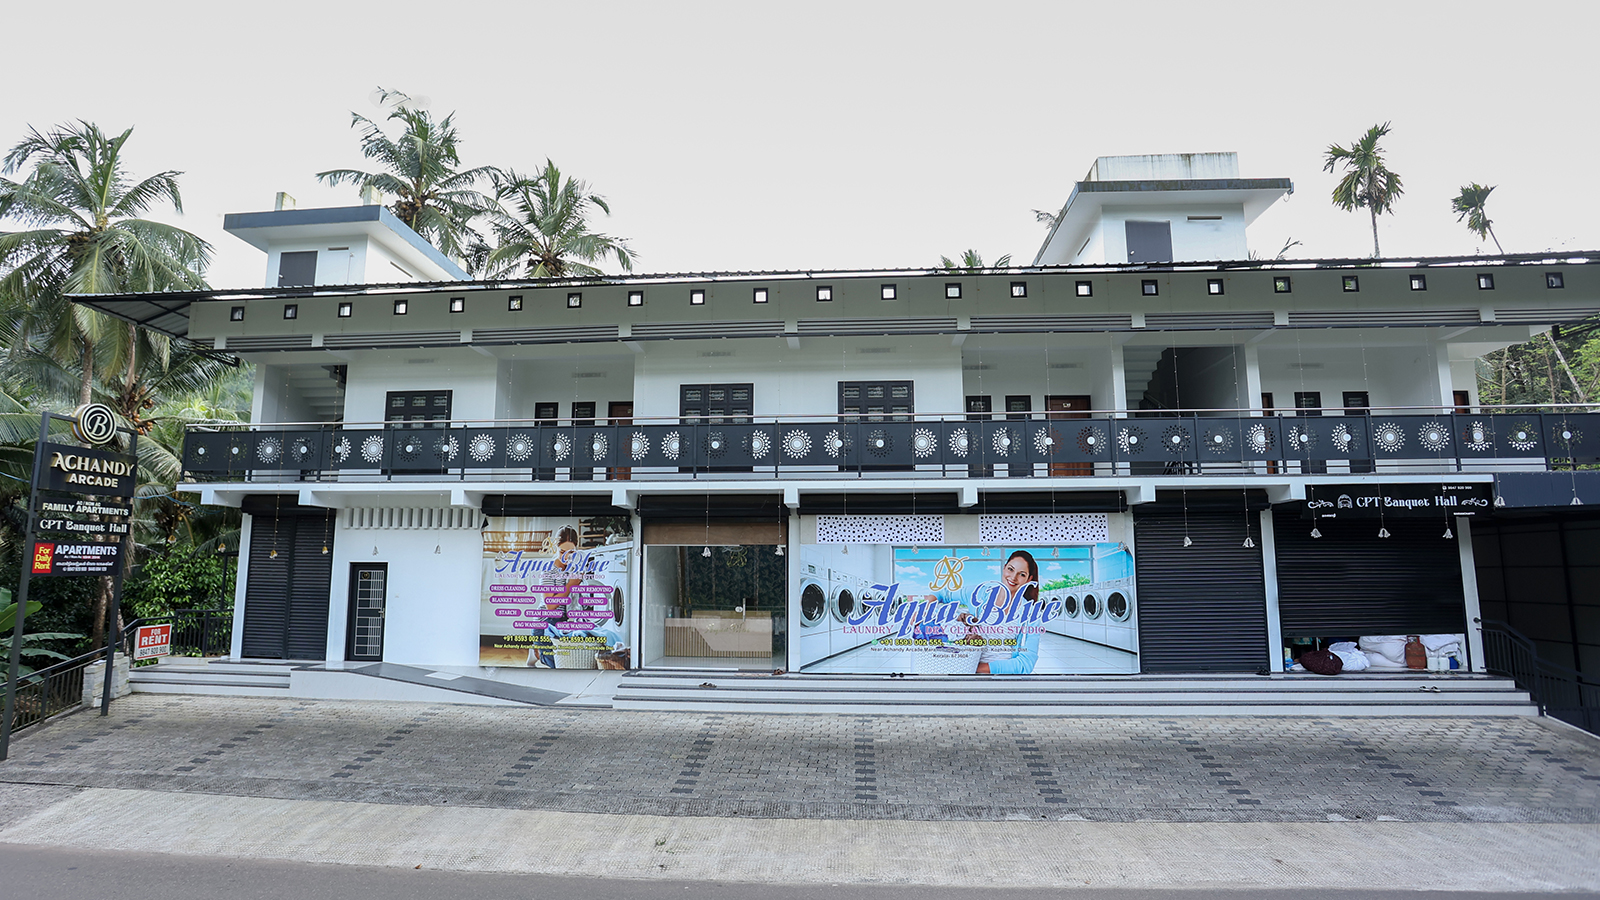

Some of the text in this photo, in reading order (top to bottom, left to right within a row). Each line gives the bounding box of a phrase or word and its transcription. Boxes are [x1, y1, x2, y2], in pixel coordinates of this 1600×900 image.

[88, 414, 108, 436] B
[52, 452, 134, 478] ACHANDY
[67, 474, 118, 488] ARCADE
[42, 502, 129, 516] FAMILY APARTMENTS
[1356, 495, 1458, 510] CPT Banquet Hall
[40, 519, 127, 533] CPT Banquet Hall
[55, 545, 117, 555] APARTMENTS
[36, 554, 52, 563] Daily
[494, 550, 610, 580] Aqua Blue
[848, 582, 1064, 638] Aqua Blue
[843, 625, 894, 634] LAUNDRY
[926, 625, 948, 634] DRY
[950, 626, 1004, 634] CLEANING
[1008, 626, 1046, 634] STUDIO
[141, 634, 168, 646] RENT
